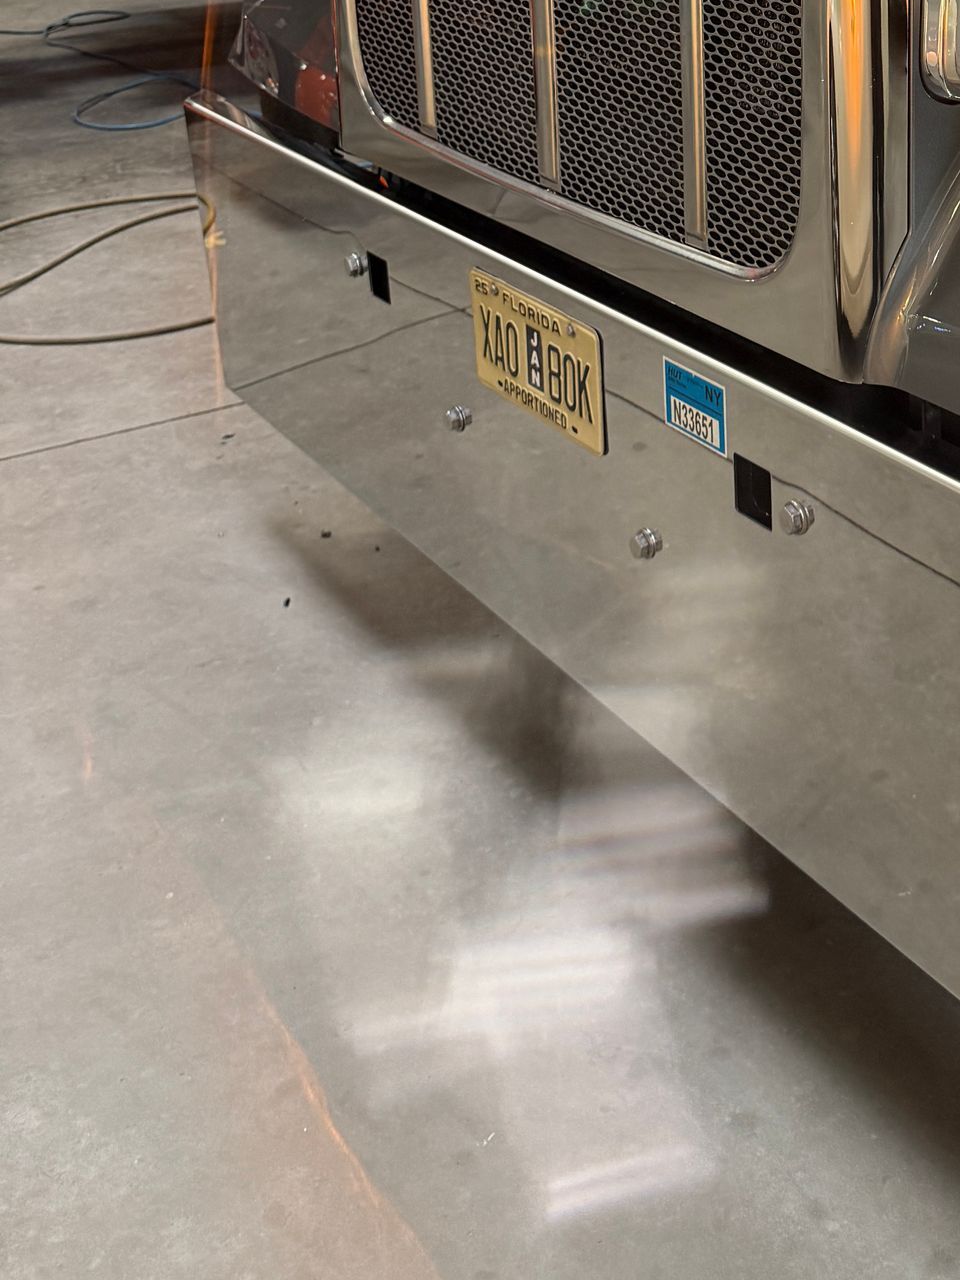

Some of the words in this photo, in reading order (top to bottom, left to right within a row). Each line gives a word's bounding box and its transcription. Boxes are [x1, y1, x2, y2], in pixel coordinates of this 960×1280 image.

[474, 278, 489, 296] 25
[502, 290, 561, 337] FLORIDA
[530, 331, 541, 388] JAN
[503, 377, 568, 430] APPORTIONED
[704, 384, 721, 407] NY
[673, 398, 714, 443] N33651
